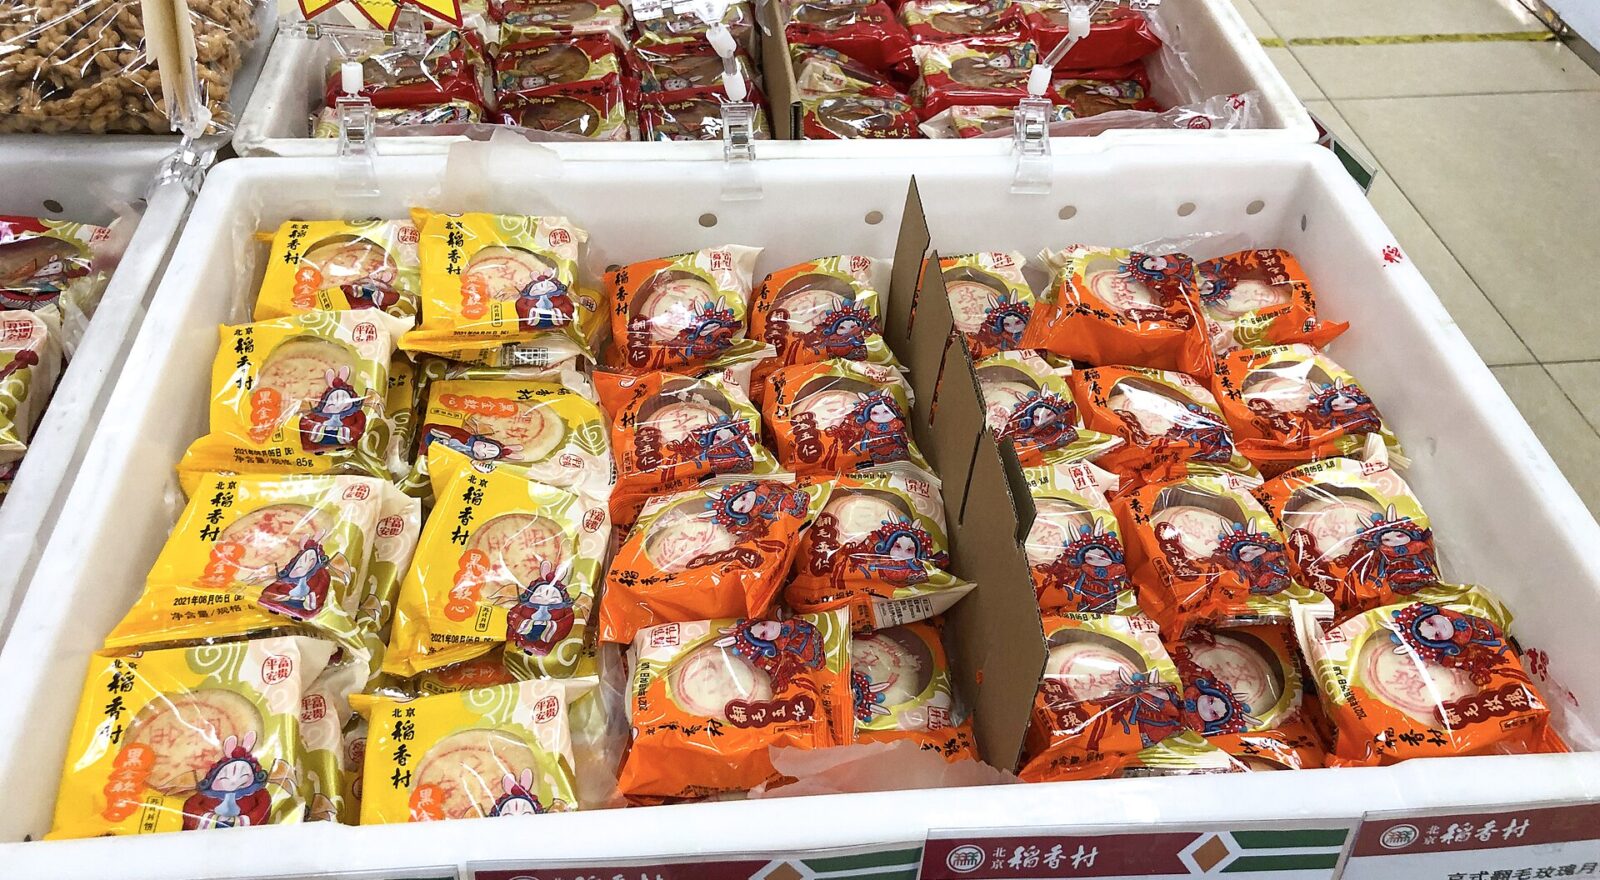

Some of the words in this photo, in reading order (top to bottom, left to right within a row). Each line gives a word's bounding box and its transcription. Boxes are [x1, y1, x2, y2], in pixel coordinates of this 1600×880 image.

[283, 229, 307, 265] 稻香村
[446, 231, 464, 276] 稻香村
[233, 326, 254, 336] 北京
[1083, 369, 1108, 408] 稻香村
[1215, 361, 1243, 401] 稻香村
[296, 457, 314, 468] 85g
[215, 481, 237, 490] 北京
[467, 474, 489, 488] 北京
[199, 491, 234, 542] 稻香村
[451, 486, 484, 546] 稻香村
[815, 516, 834, 570] 翻毛五仁
[391, 707, 416, 718] 北京
[729, 700, 805, 723] 翻毛五仁
[1442, 686, 1526, 726] 翻毛玫瑰
[390, 719, 415, 790] 稻香村
[1423, 824, 1440, 846] 北京
[1439, 818, 1530, 844] 稻香村
[991, 846, 1005, 870] 北京
[1007, 844, 1099, 871] 稻香村
[1447, 862, 1600, 880] 京式翻毛玫瑰月
